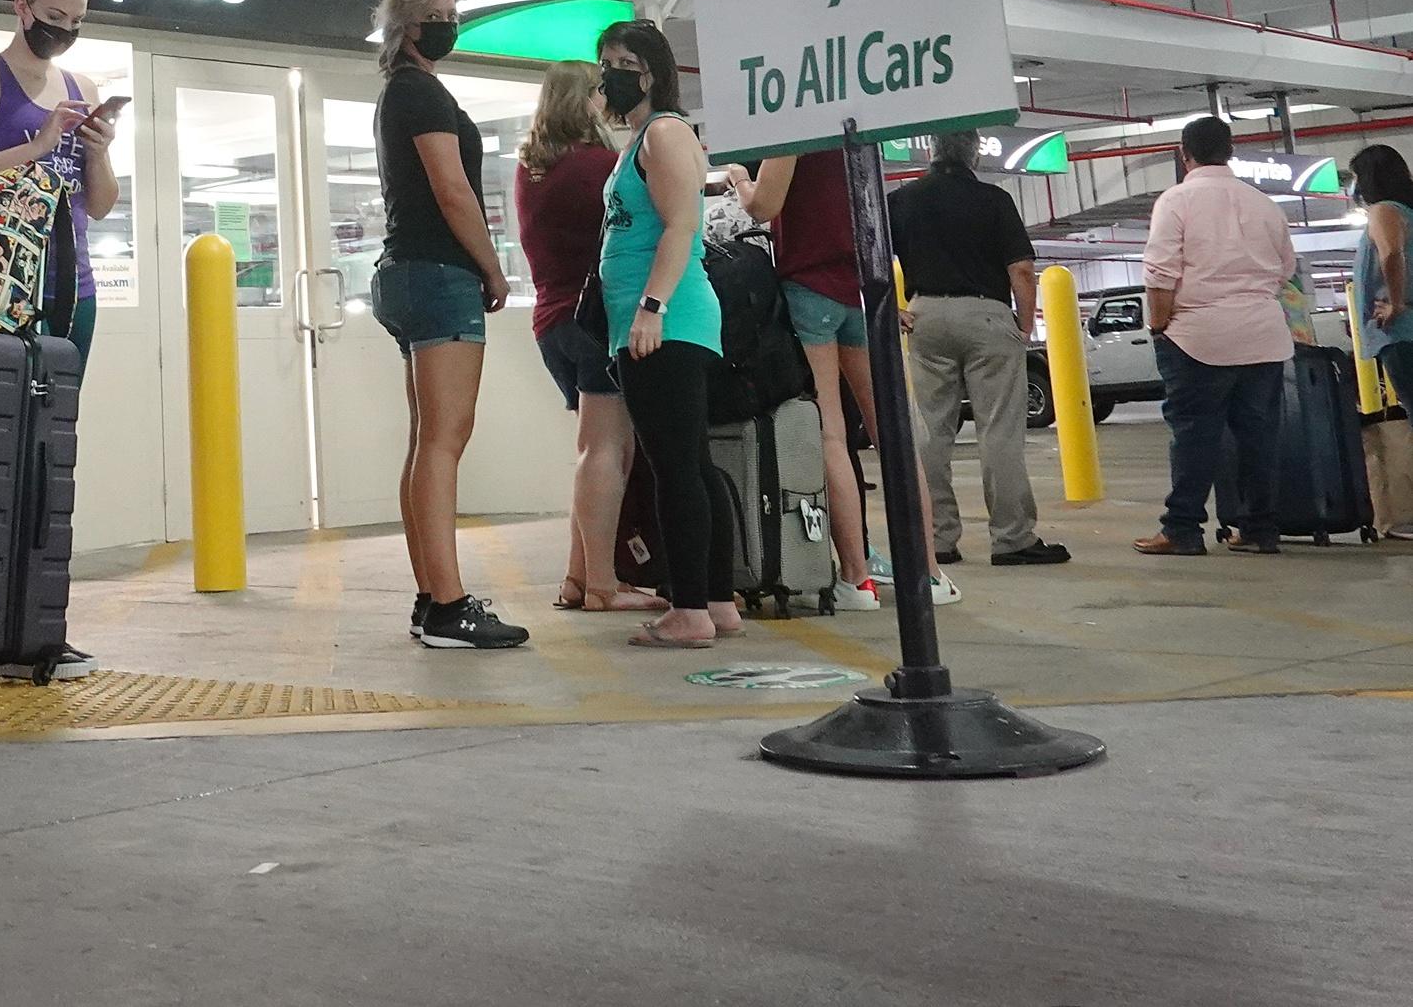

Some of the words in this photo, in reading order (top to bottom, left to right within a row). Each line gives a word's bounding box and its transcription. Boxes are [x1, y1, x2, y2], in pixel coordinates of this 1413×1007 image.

[739, 55, 786, 116] To
[794, 35, 847, 108] All
[857, 29, 955, 96] Cars
